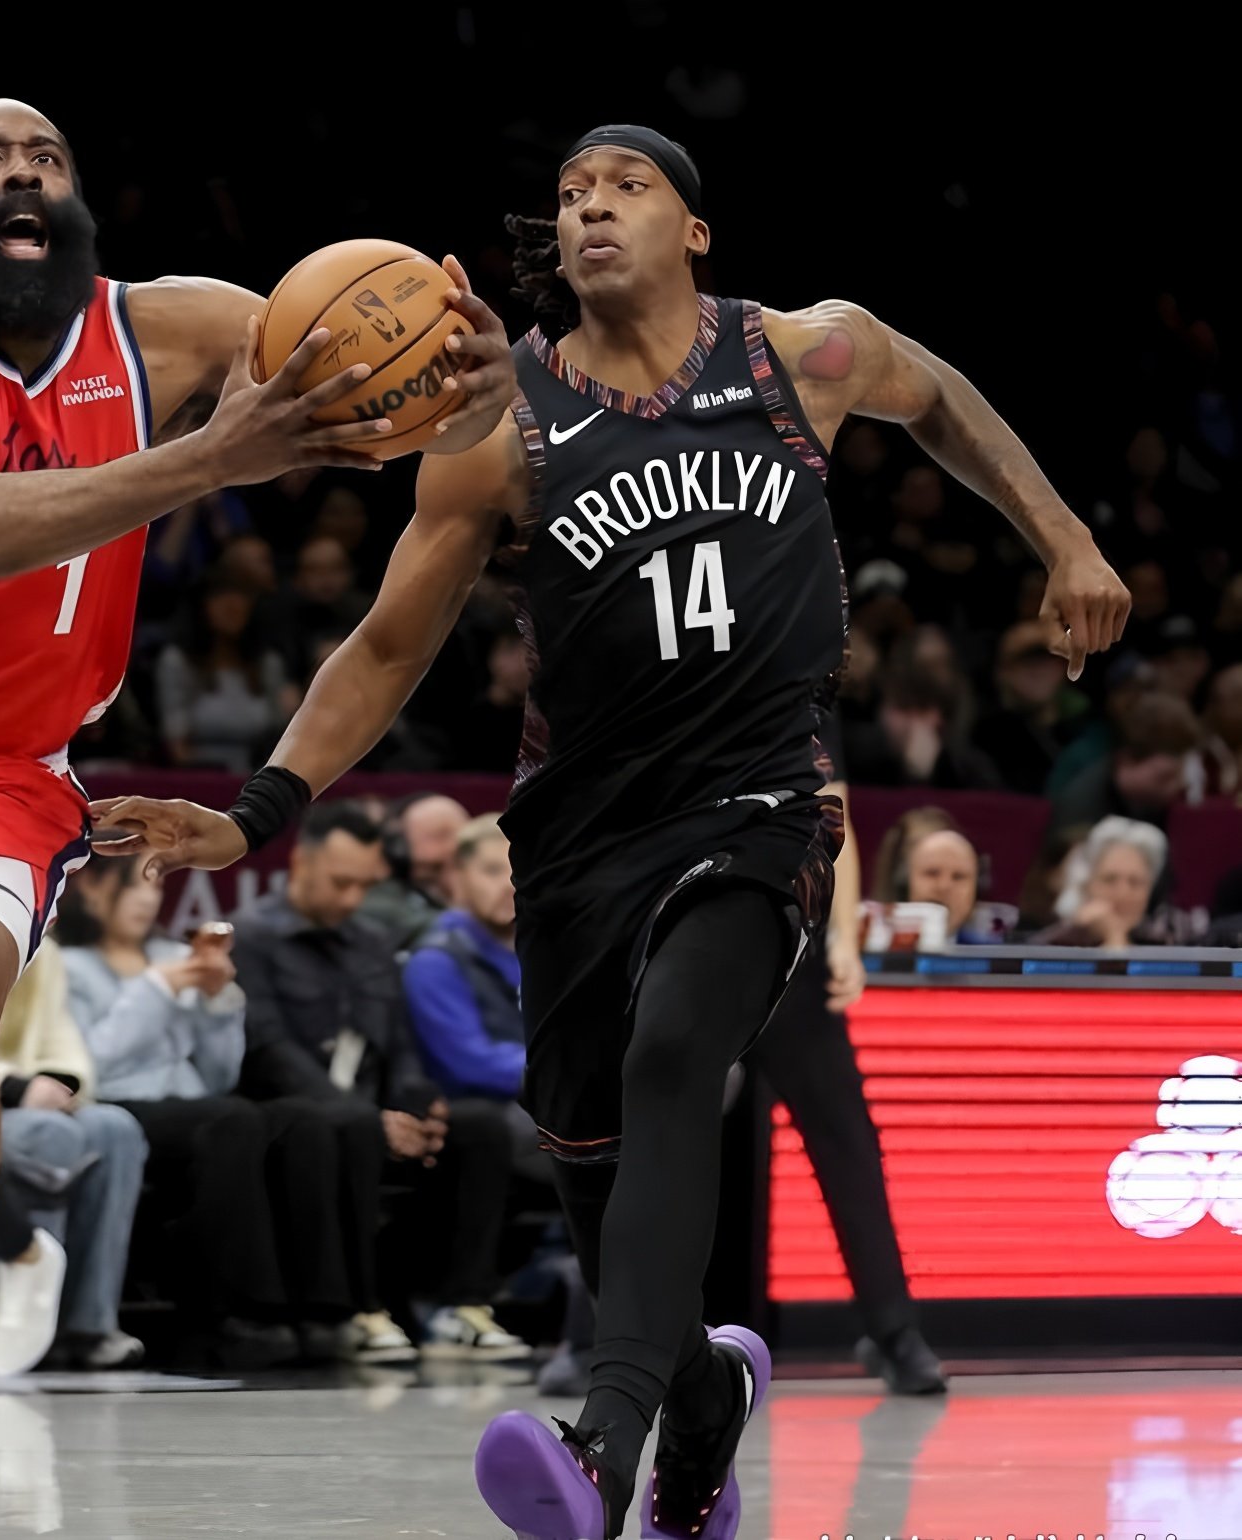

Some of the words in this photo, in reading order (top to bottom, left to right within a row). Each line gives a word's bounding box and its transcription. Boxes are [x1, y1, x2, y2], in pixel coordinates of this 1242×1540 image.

[70, 374, 108, 391] VISIT
[61, 385, 125, 406] RWANDA
[692, 393, 710, 410] All
[710, 392, 725, 406] In
[548, 450, 796, 571] BROOKLYN
[638, 540, 736, 661] 14
